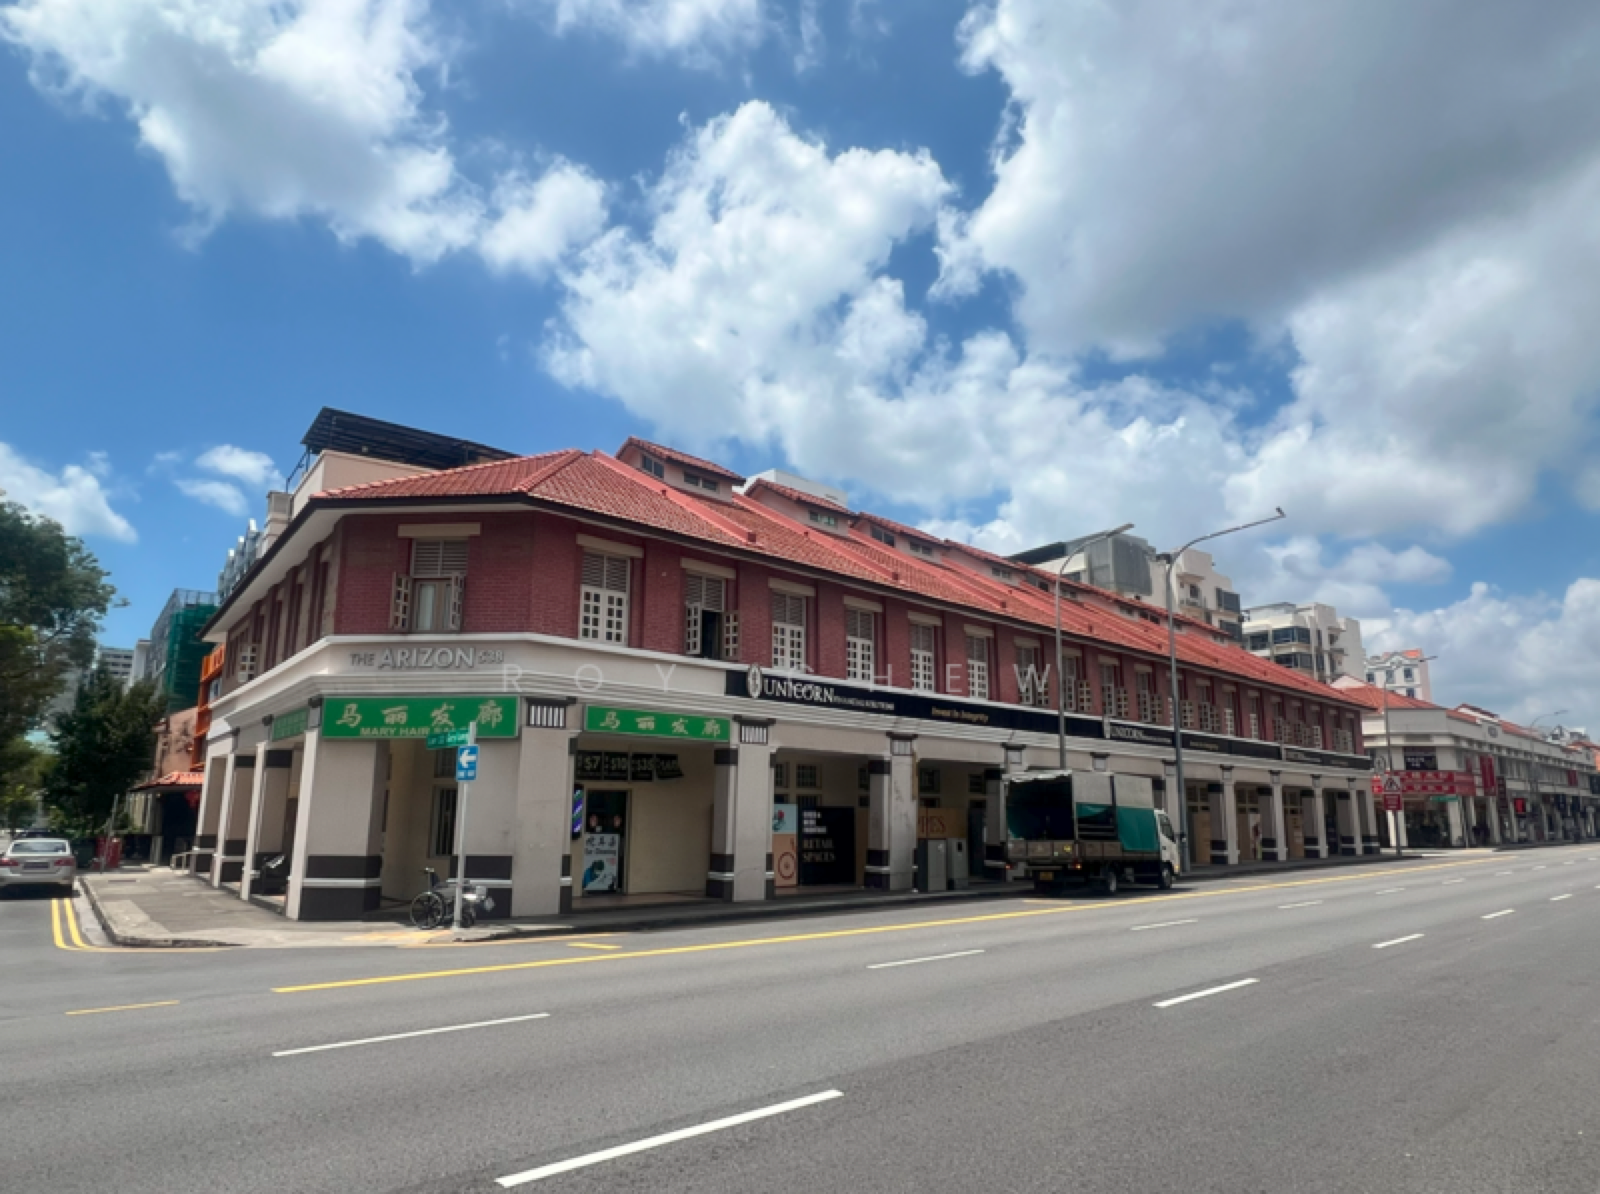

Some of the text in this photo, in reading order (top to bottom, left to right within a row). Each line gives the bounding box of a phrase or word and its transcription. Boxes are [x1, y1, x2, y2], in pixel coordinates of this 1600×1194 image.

[350, 652, 375, 667] THE
[378, 646, 477, 670] ARIZON
[763, 677, 835, 703] UNICORN
[335, 700, 503, 728] 马丽发廊
[599, 711, 721, 738] 马丽发廊
[360, 727, 396, 737] MARY
[400, 727, 430, 737] HAIR
